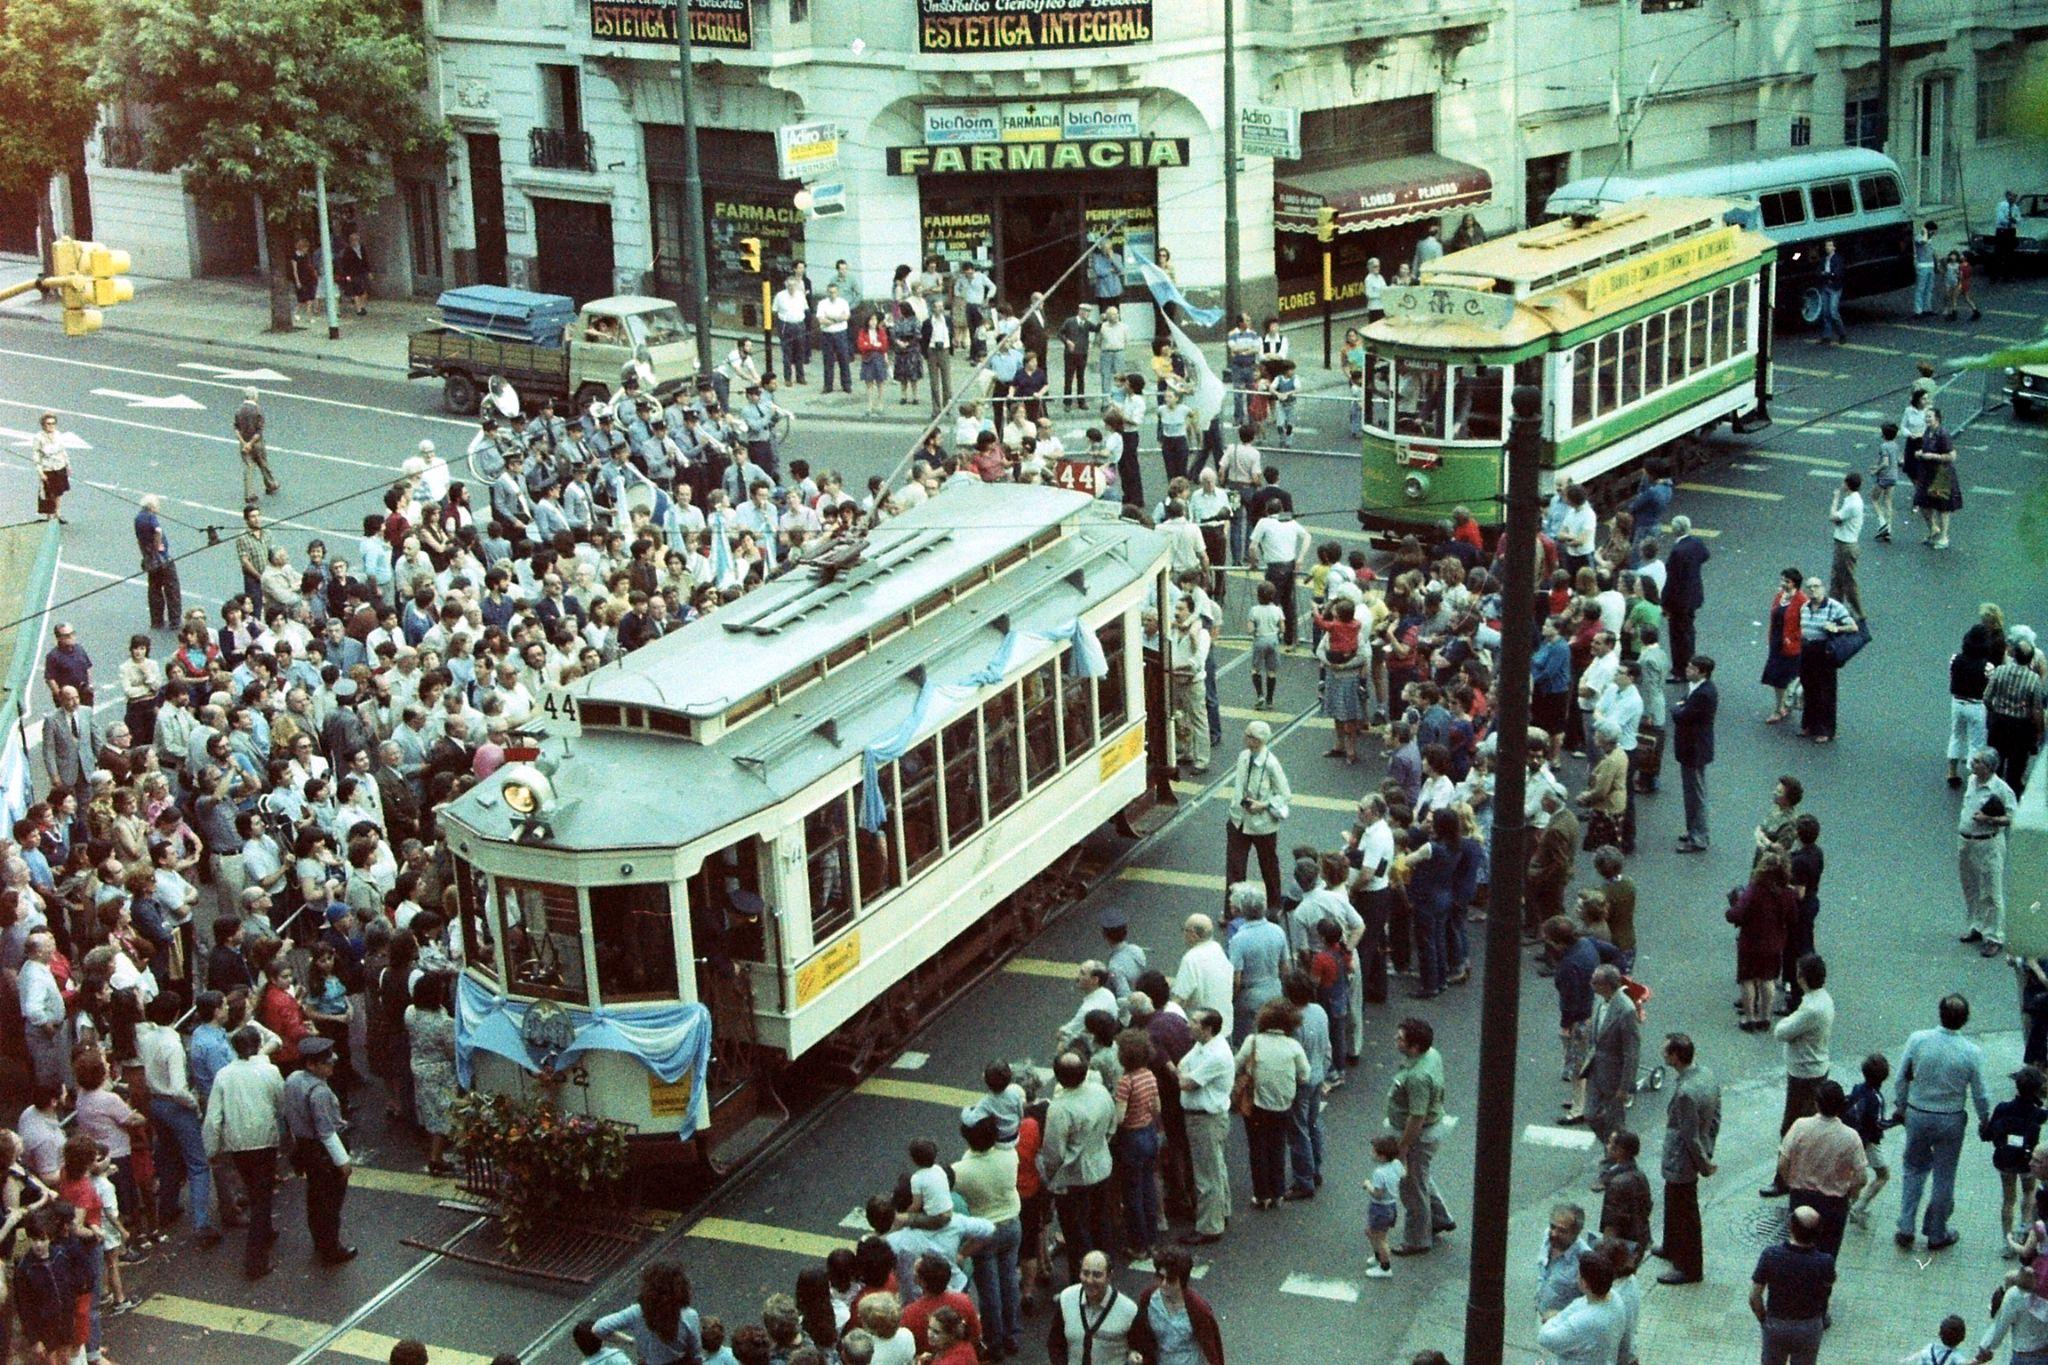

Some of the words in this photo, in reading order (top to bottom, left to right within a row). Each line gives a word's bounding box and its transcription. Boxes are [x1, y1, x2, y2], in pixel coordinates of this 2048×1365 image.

[594, 6, 668, 39] ESTETICA
[671, 10, 748, 43] ITEGRAL
[924, 14, 1035, 48] ESTETICA
[1040, 8, 1150, 44] INTEGRAL
[1003, 115, 1060, 129] FARMACIA
[1242, 108, 1272, 125] Adiro
[900, 141, 1181, 174] FARMACIA
[1359, 192, 1396, 208] FLORES
[1418, 182, 1458, 199] PLANTAS
[715, 202, 806, 224] FARMACIA
[924, 214, 991, 228] FARMACIA
[1085, 207, 1153, 220] PERFUMERIA
[1279, 291, 1316, 311] FLORES
[1331, 281, 1365, 300] PLANTA
[1060, 464, 1095, 489] 44
[544, 693, 576, 722] 44
